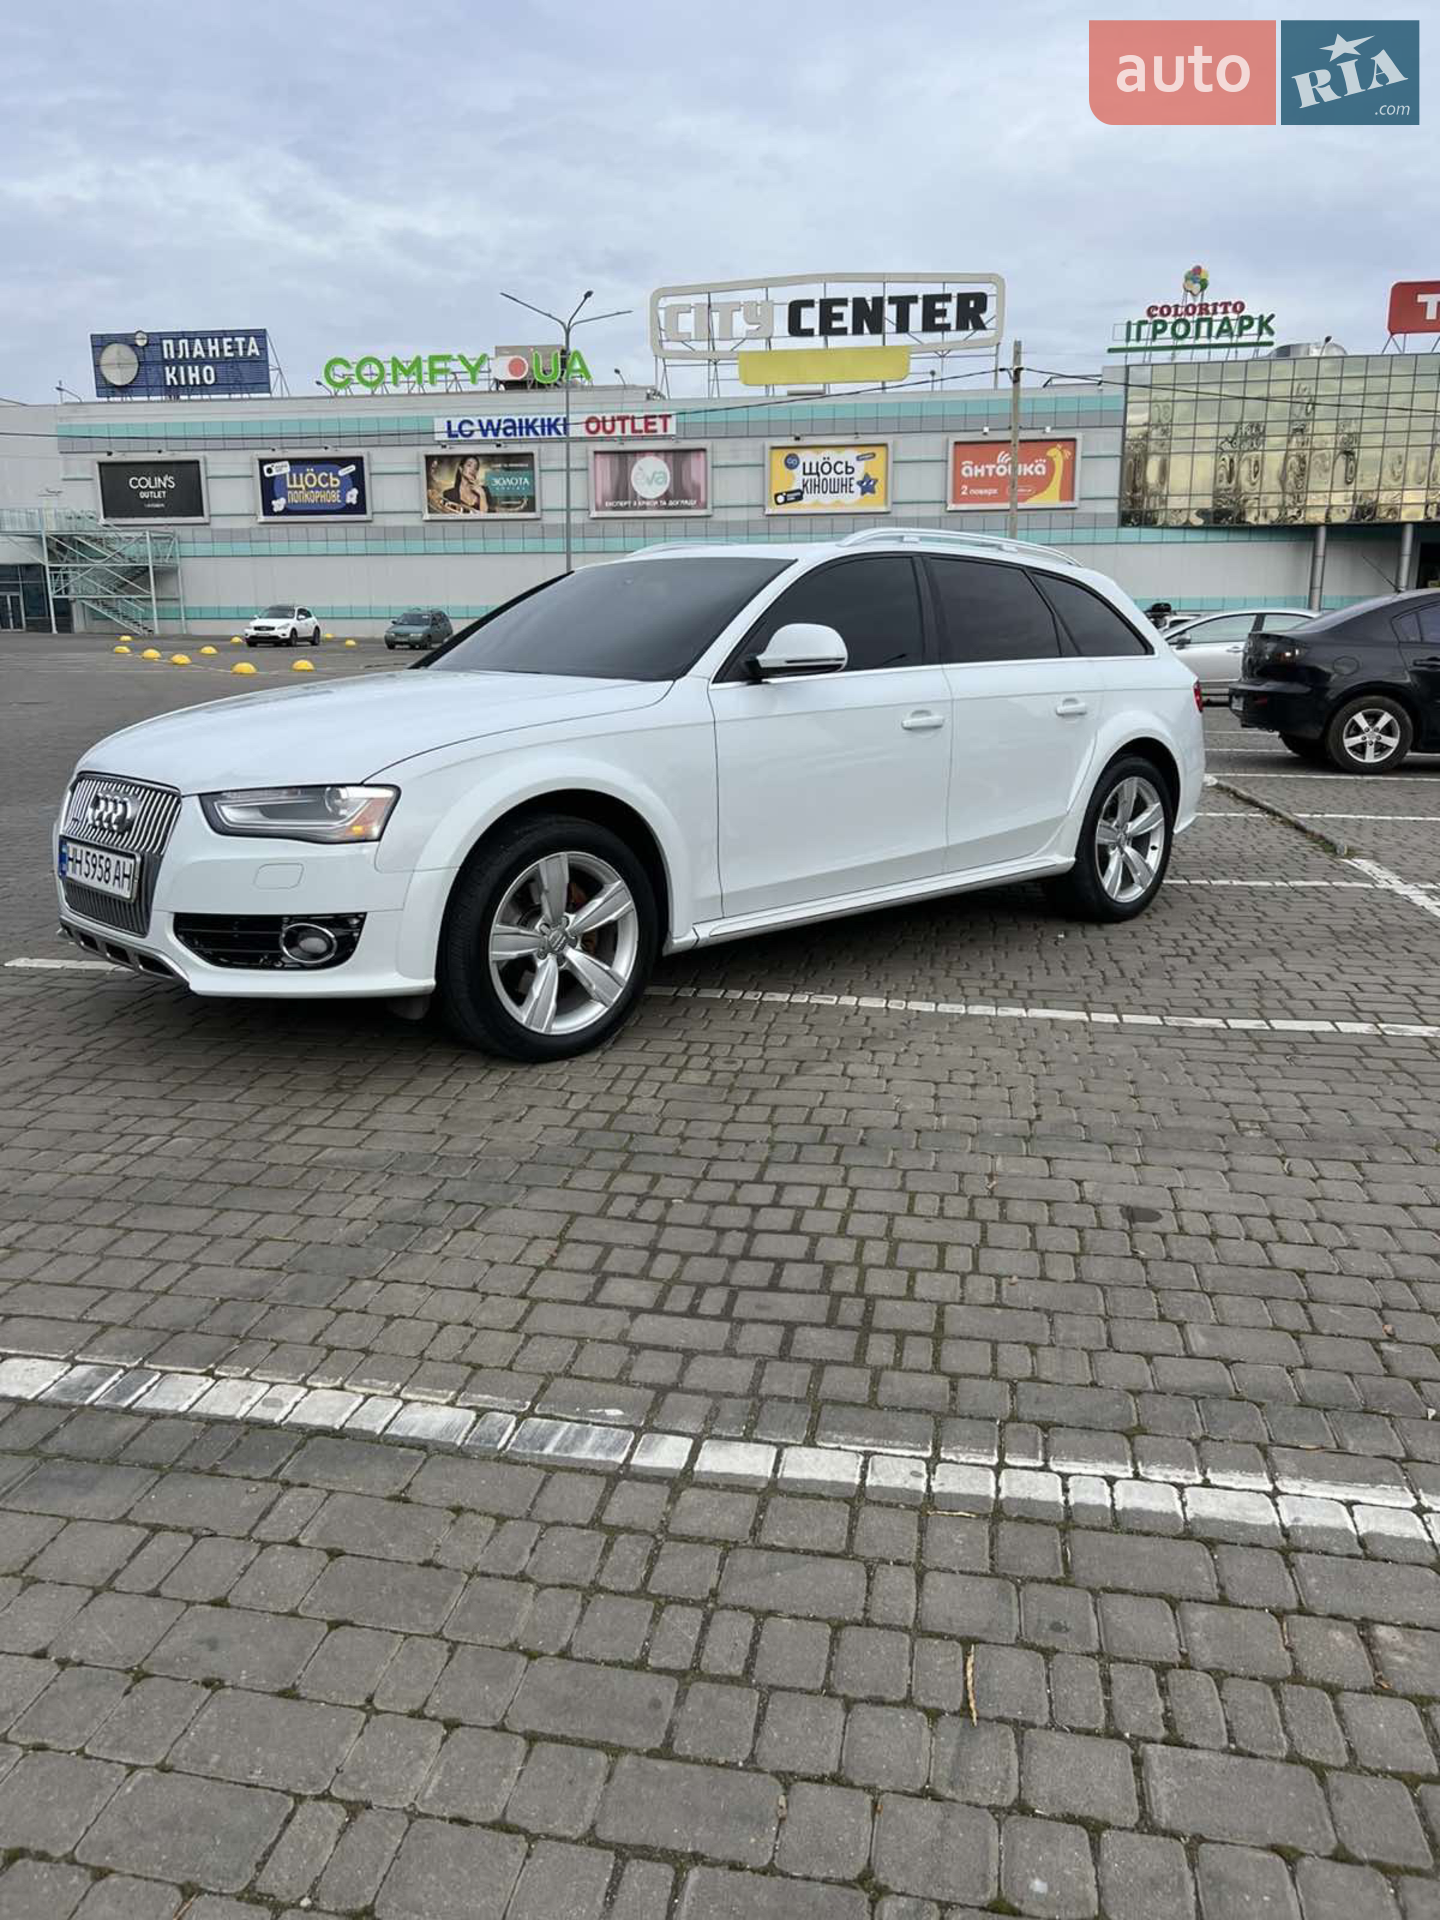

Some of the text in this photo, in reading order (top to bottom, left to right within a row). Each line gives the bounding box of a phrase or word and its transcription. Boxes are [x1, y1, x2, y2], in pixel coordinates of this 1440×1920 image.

[663, 291, 988, 342] CITY CENTER
[1146, 301, 1246, 318] COLORITO
[1125, 313, 1276, 343] ІГРОПАРК
[162, 336, 260, 359] ПЛАНЕТА
[164, 365, 216, 386] КІНО
[324, 353, 489, 389] COMFY
[446, 419, 475, 439] LC
[584, 414, 673, 435] OUTLET
[128, 474, 176, 489] COLIN'S
[491, 477, 530, 487] ЗОЛОТА
[802, 477, 855, 495] КІНОШНЕ
[960, 485, 968, 496] 2
[139, 490, 167, 499] OUTLET
[84, 851, 112, 885] 5958
[113, 860, 133, 892] AH
